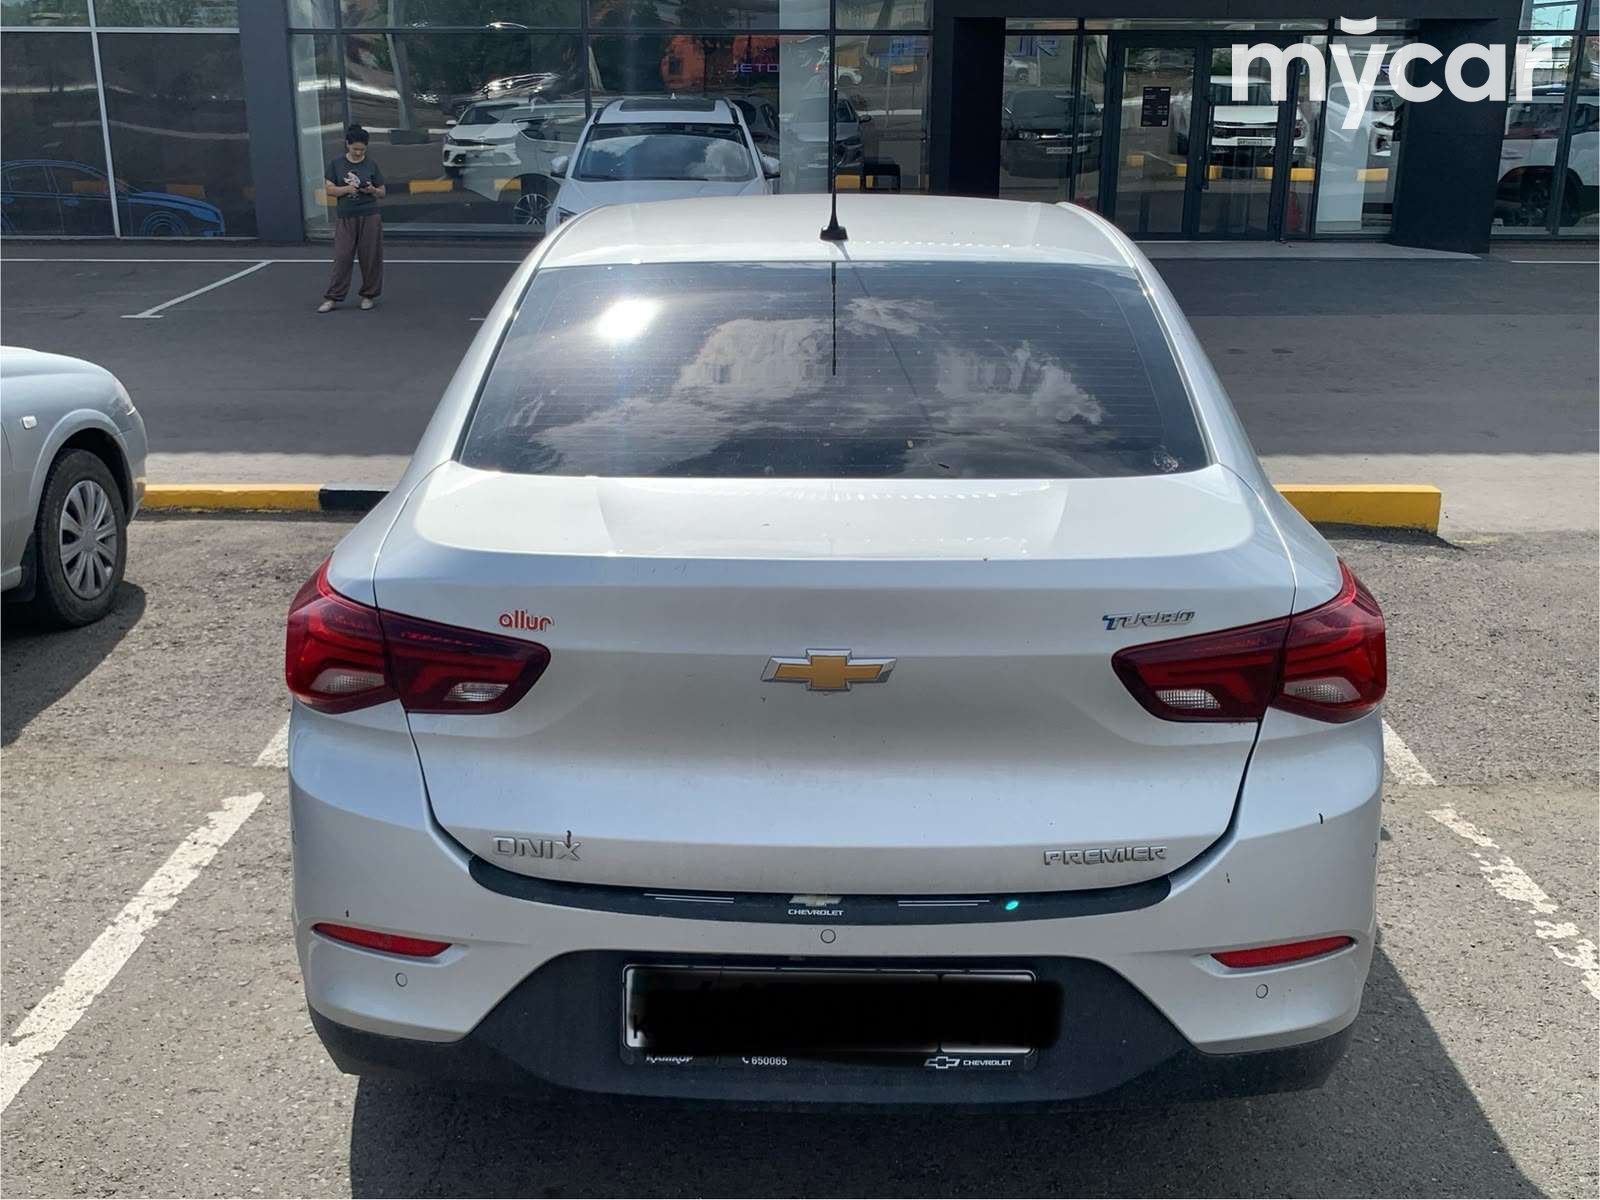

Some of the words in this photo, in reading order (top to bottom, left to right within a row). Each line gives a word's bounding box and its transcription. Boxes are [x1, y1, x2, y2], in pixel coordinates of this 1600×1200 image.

[499, 609, 553, 631] allur
[1102, 610, 1196, 631] TURBO
[493, 836, 582, 861] ONIX
[1043, 846, 1168, 866] PREMIER
[787, 908, 844, 916] CHEVROLET
[751, 1056, 788, 1066] 650065
[963, 1059, 1013, 1067] CHEVROLET
